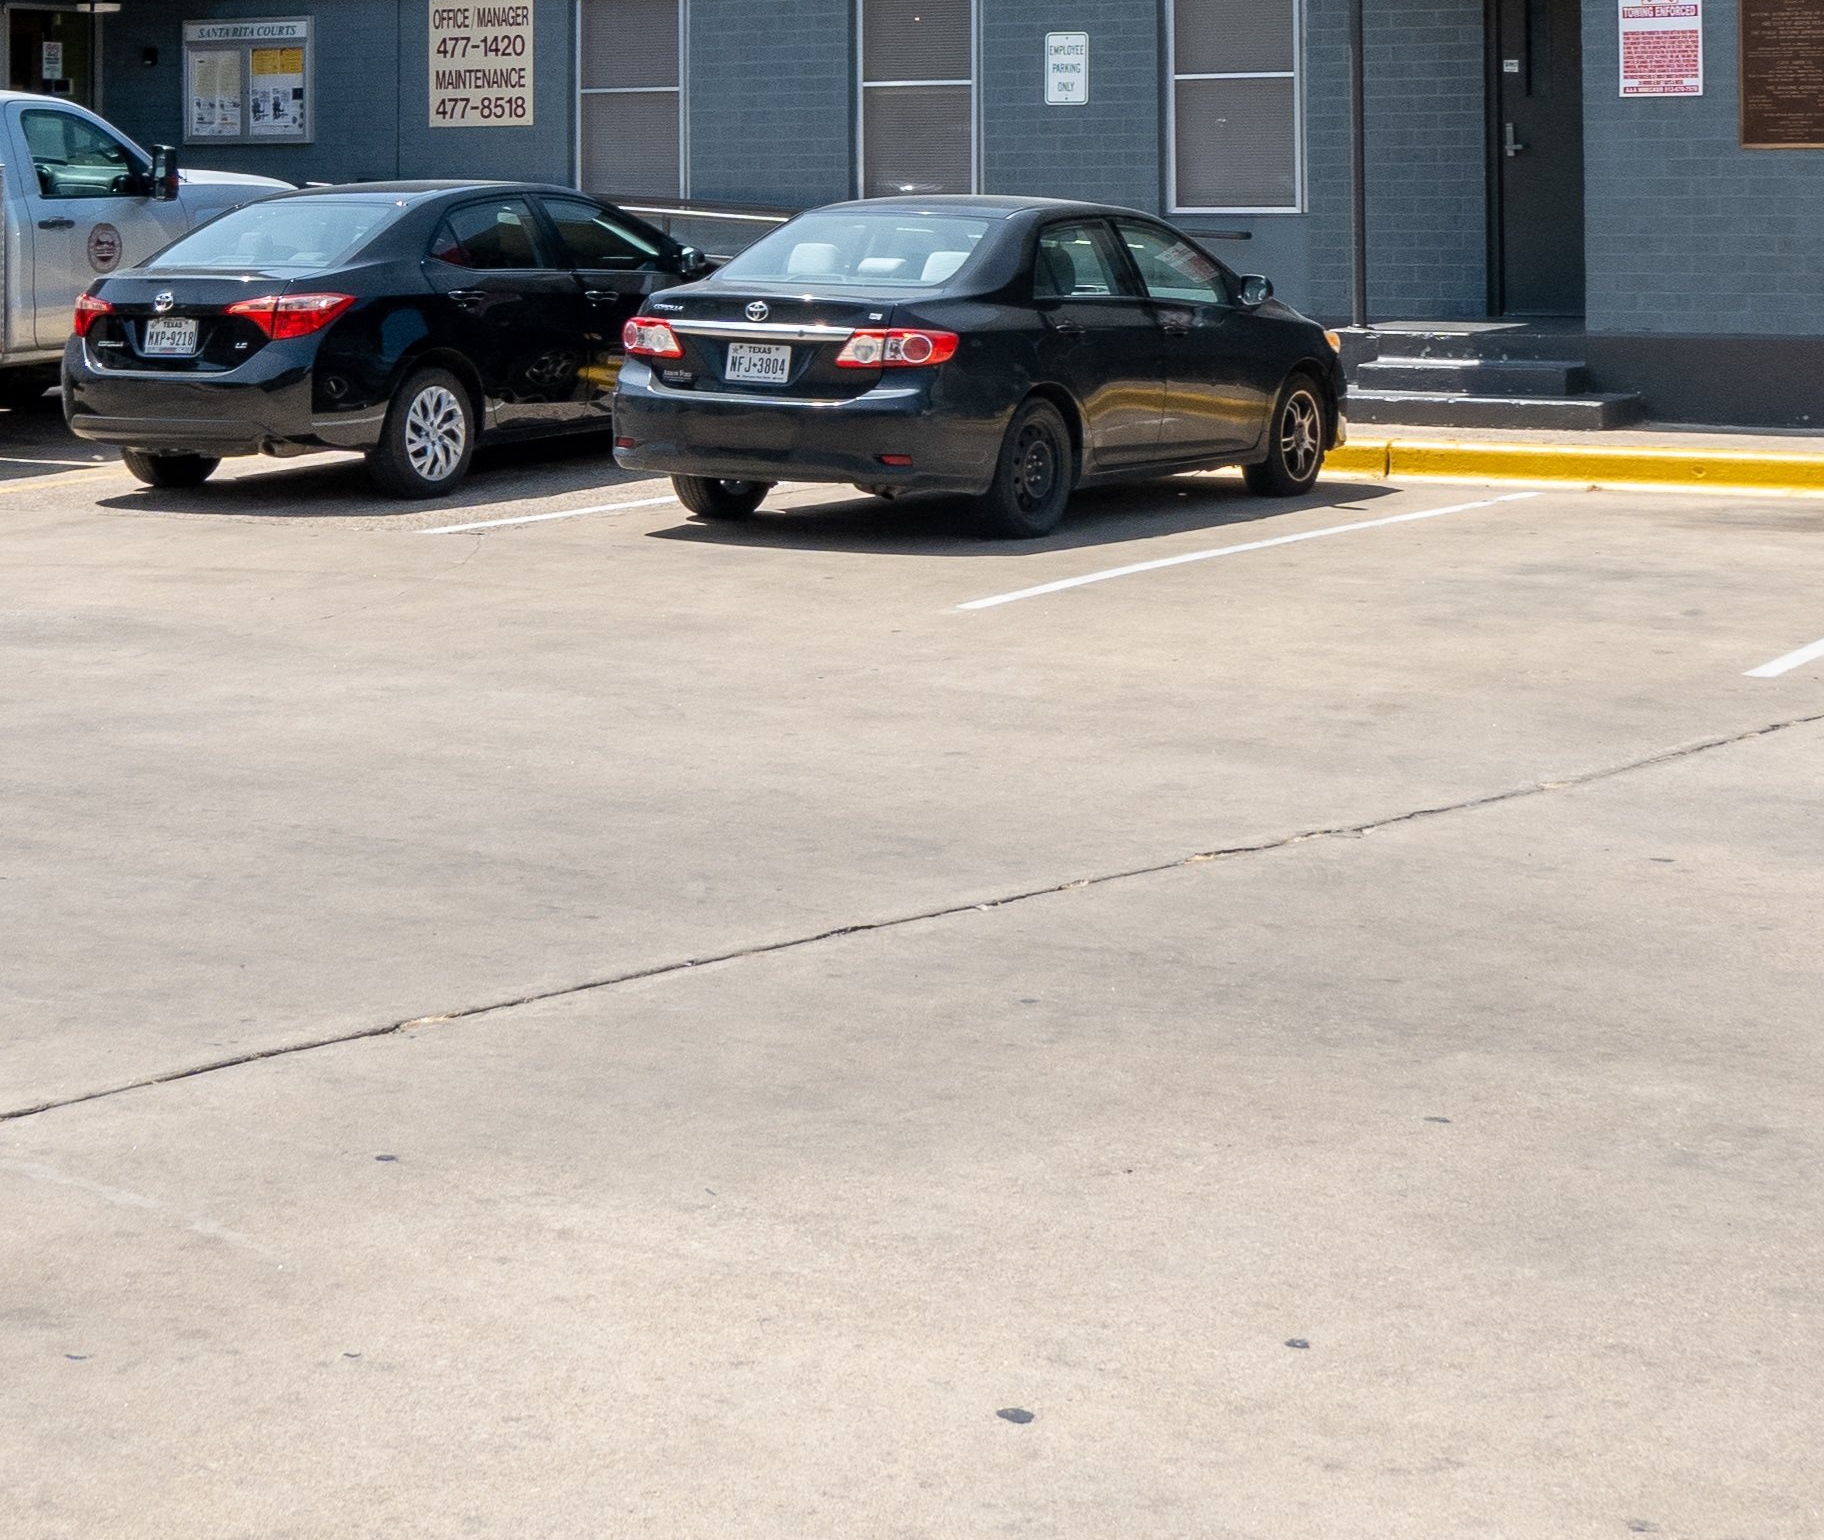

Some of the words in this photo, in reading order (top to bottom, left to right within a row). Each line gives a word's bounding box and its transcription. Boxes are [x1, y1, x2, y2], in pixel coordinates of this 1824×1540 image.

[1623, 7, 1654, 18] TOWING
[1655, 5, 1696, 17] ENFORCED
[198, 27, 230, 39] SANTA
[231, 26, 255, 37] RITA
[257, 25, 297, 37] COURTS
[436, 34, 526, 59] 477-1420
[1049, 44, 1085, 56] EMPLOYEE
[1052, 63, 1081, 73] PARKING
[435, 67, 526, 90] MAINTENANCE
[1057, 81, 1075, 92] ONLY
[435, 96, 526, 120] 477-8518
[748, 346, 772, 355] TEXAS
